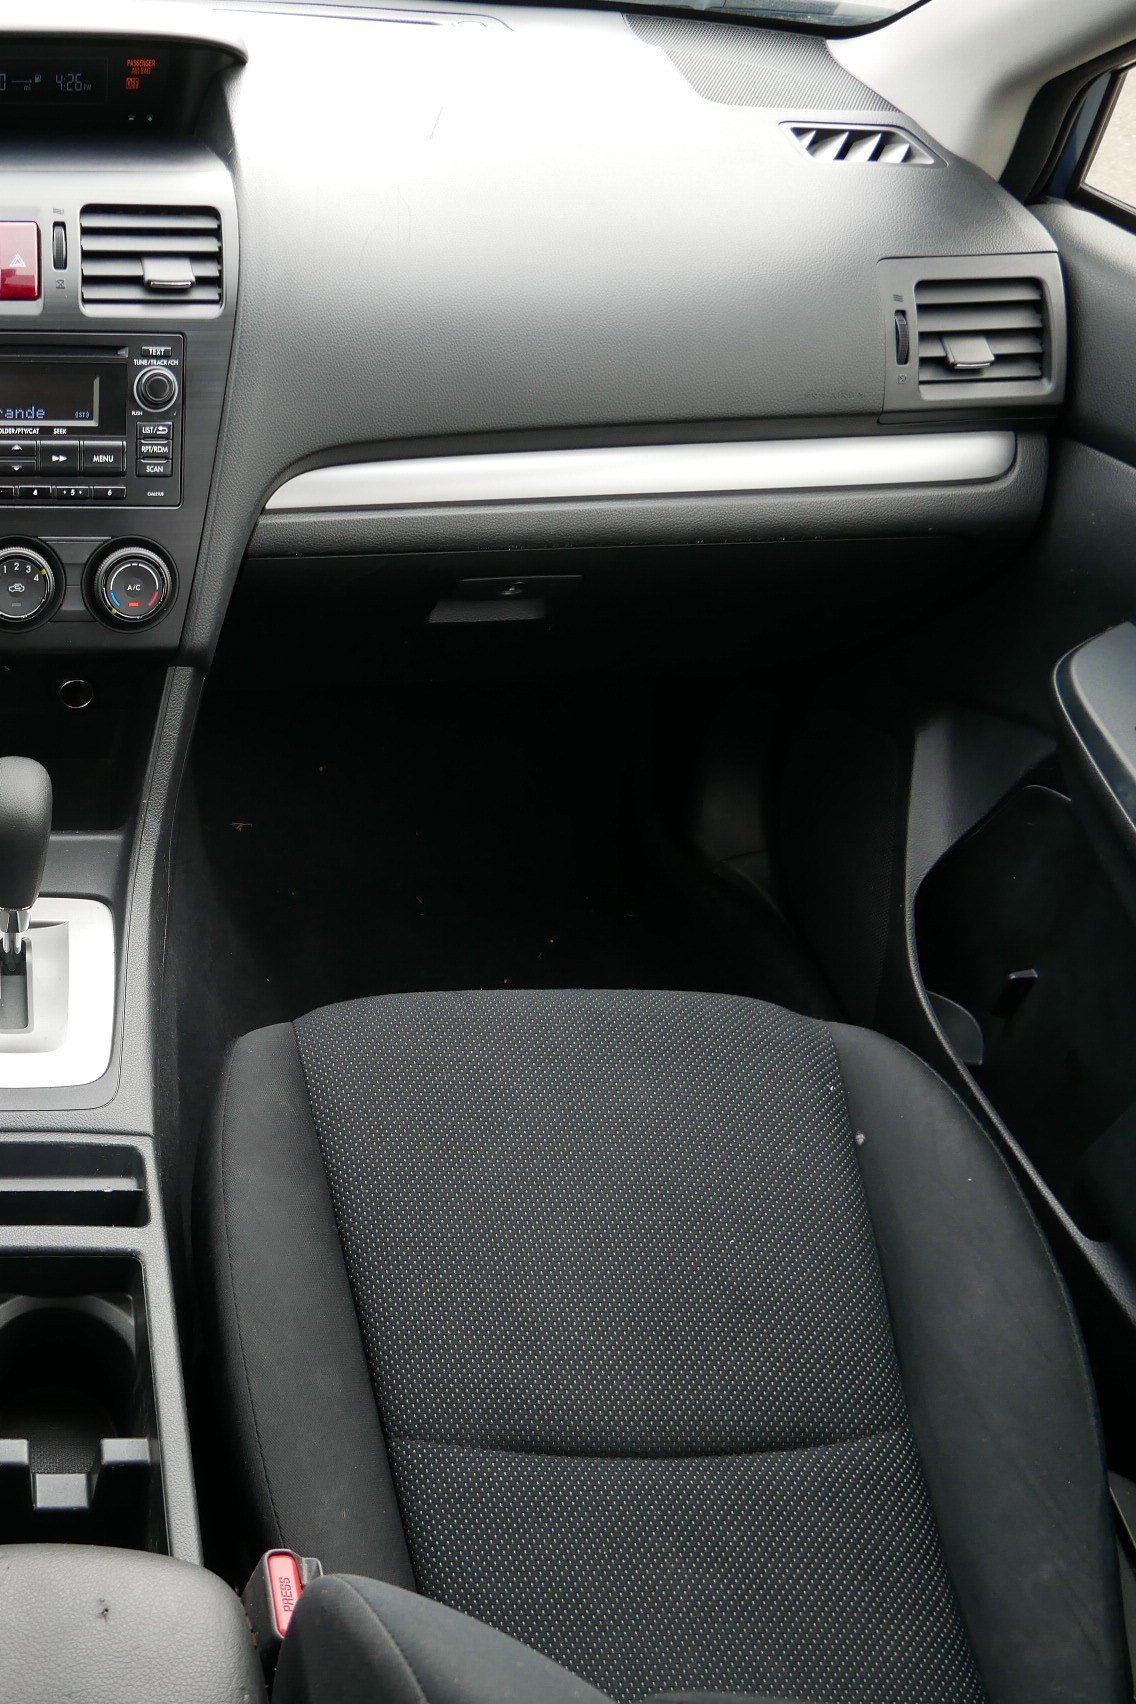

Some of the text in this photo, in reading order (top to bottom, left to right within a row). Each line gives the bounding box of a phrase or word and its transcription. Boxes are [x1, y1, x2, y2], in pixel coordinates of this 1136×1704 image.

[127, 59, 156, 67] PASSENGER
[55, 73, 83, 91] 4:26
[149, 348, 165, 356] TEXT
[141, 445, 169, 453] RPT/RDM
[93, 455, 114, 463] MENU
[14, 562, 20, 571] 2
[33, 574, 40, 582] 4
[279, 1576, 295, 1612] PRESS
